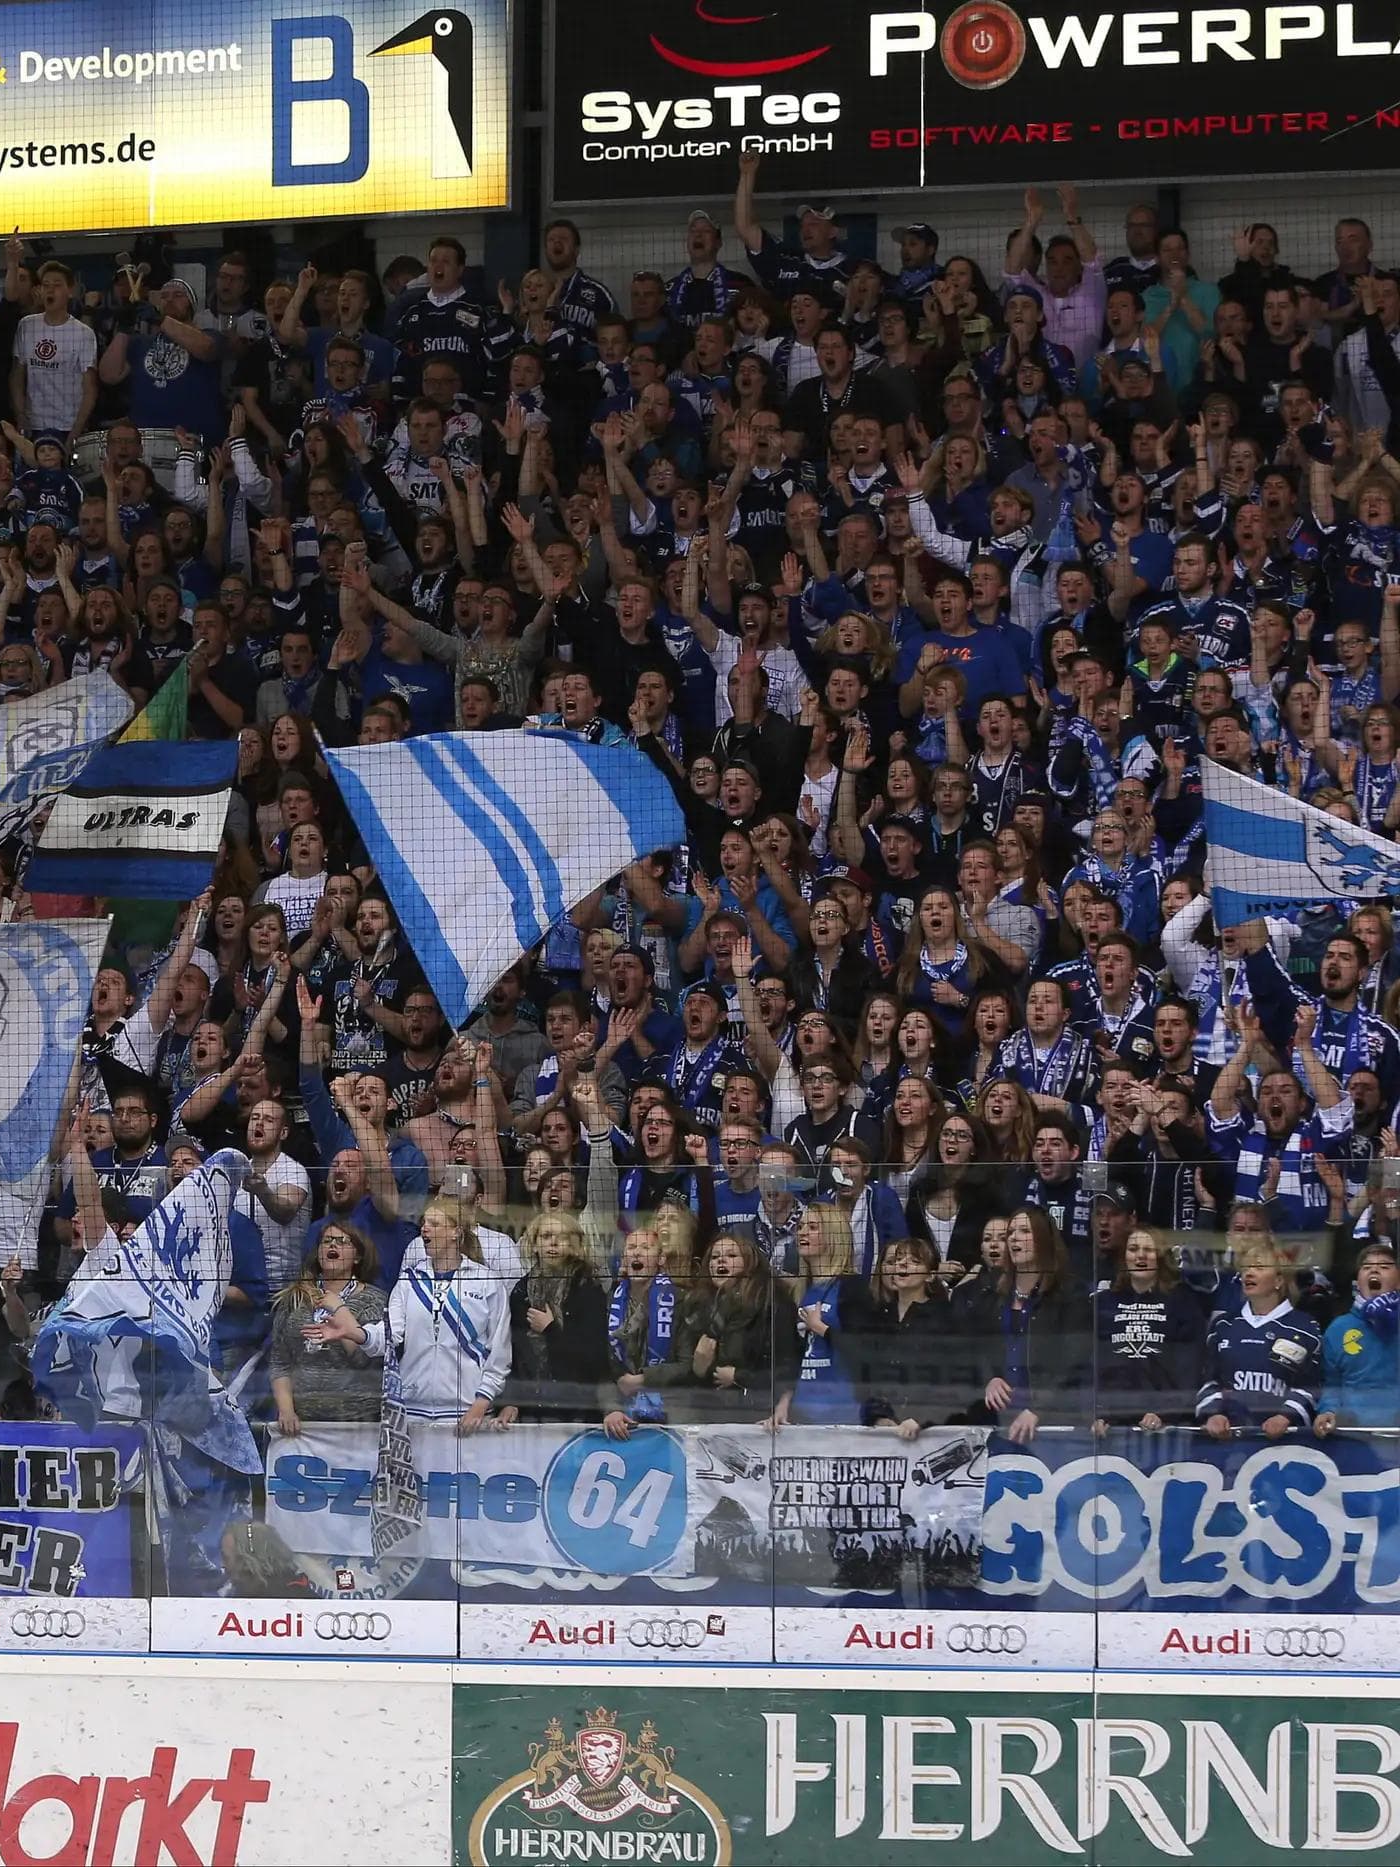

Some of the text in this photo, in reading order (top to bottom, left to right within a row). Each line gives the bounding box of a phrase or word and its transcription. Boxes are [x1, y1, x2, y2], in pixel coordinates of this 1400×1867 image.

[19, 43, 242, 85] Development
[582, 84, 842, 142] SysTec
[869, 112, 1329, 150] SOFTWARE COMPUTER
[583, 133, 834, 163] Computer GmbH
[83, 805, 201, 833] ULTRAS
[657, 1292, 676, 1339] ERC
[1125, 1325, 1151, 1334] ERC
[772, 1458, 907, 1482] SICHERHEITSWAHN
[273, 1454, 540, 1524] Szne
[567, 1451, 676, 1550] 64
[773, 1478, 903, 1506] ZERSTÖRT
[773, 1506, 901, 1529] FANKULTUR
[218, 1611, 303, 1638] Audi
[529, 1619, 615, 1646] Audi
[843, 1624, 934, 1650] Audi
[1160, 1628, 1252, 1655] Audi
[531, 1777, 668, 1822] PREMIUM INGOLSTADT BAVARIA
[494, 1828, 706, 1863] HERRNBRÄU
